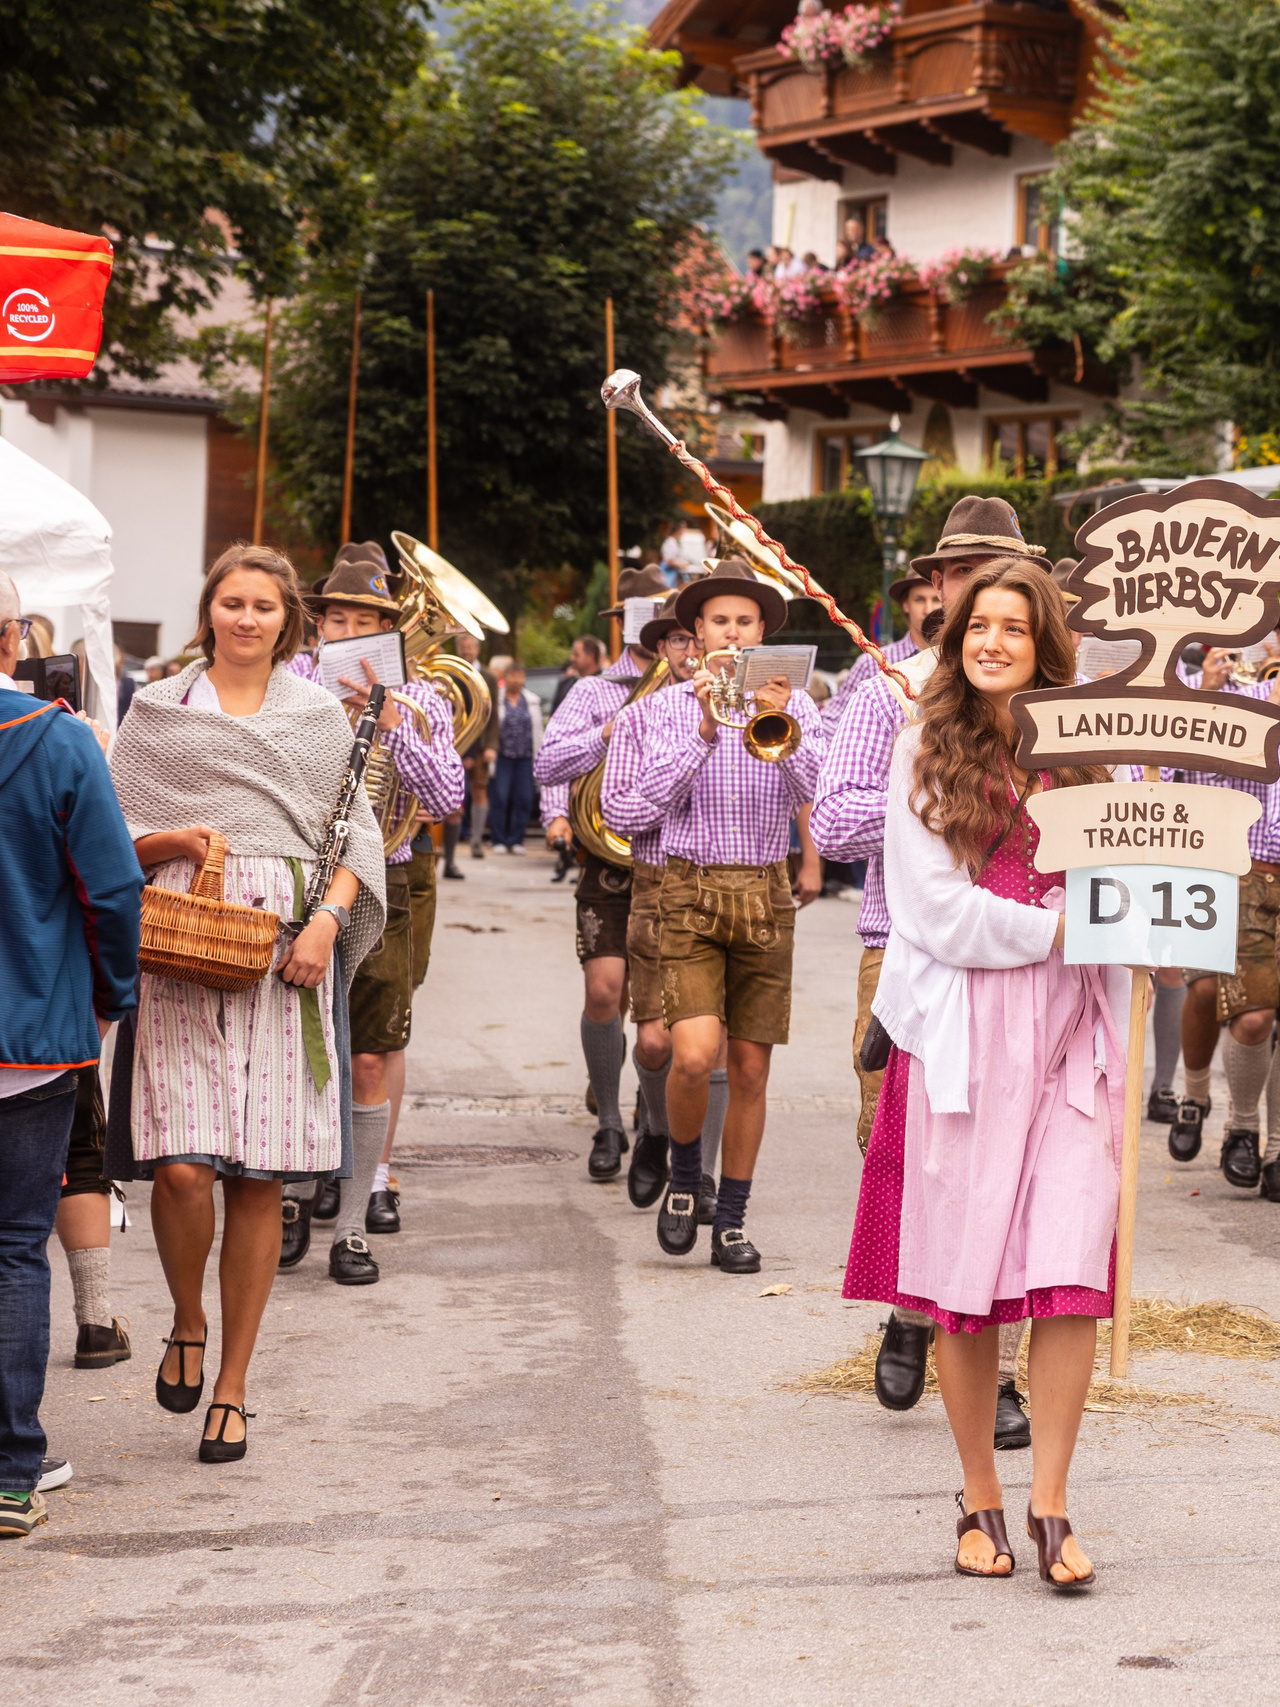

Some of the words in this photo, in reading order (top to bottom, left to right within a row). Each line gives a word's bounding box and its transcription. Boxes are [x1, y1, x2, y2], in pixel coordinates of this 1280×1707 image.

[9, 314, 49, 323] RECYCLED
[17, 303, 39, 313] 100%
[1114, 516, 1280, 574] BAUERN
[1112, 566, 1259, 621] HERBST
[1057, 713, 1247, 748] LANDJUGEND
[1100, 802, 1165, 823] JUNG
[1172, 803, 1189, 824] &
[1083, 826, 1205, 850] TRACHTIG
[1089, 877, 1131, 925] D
[1150, 881, 1218, 931] 13
